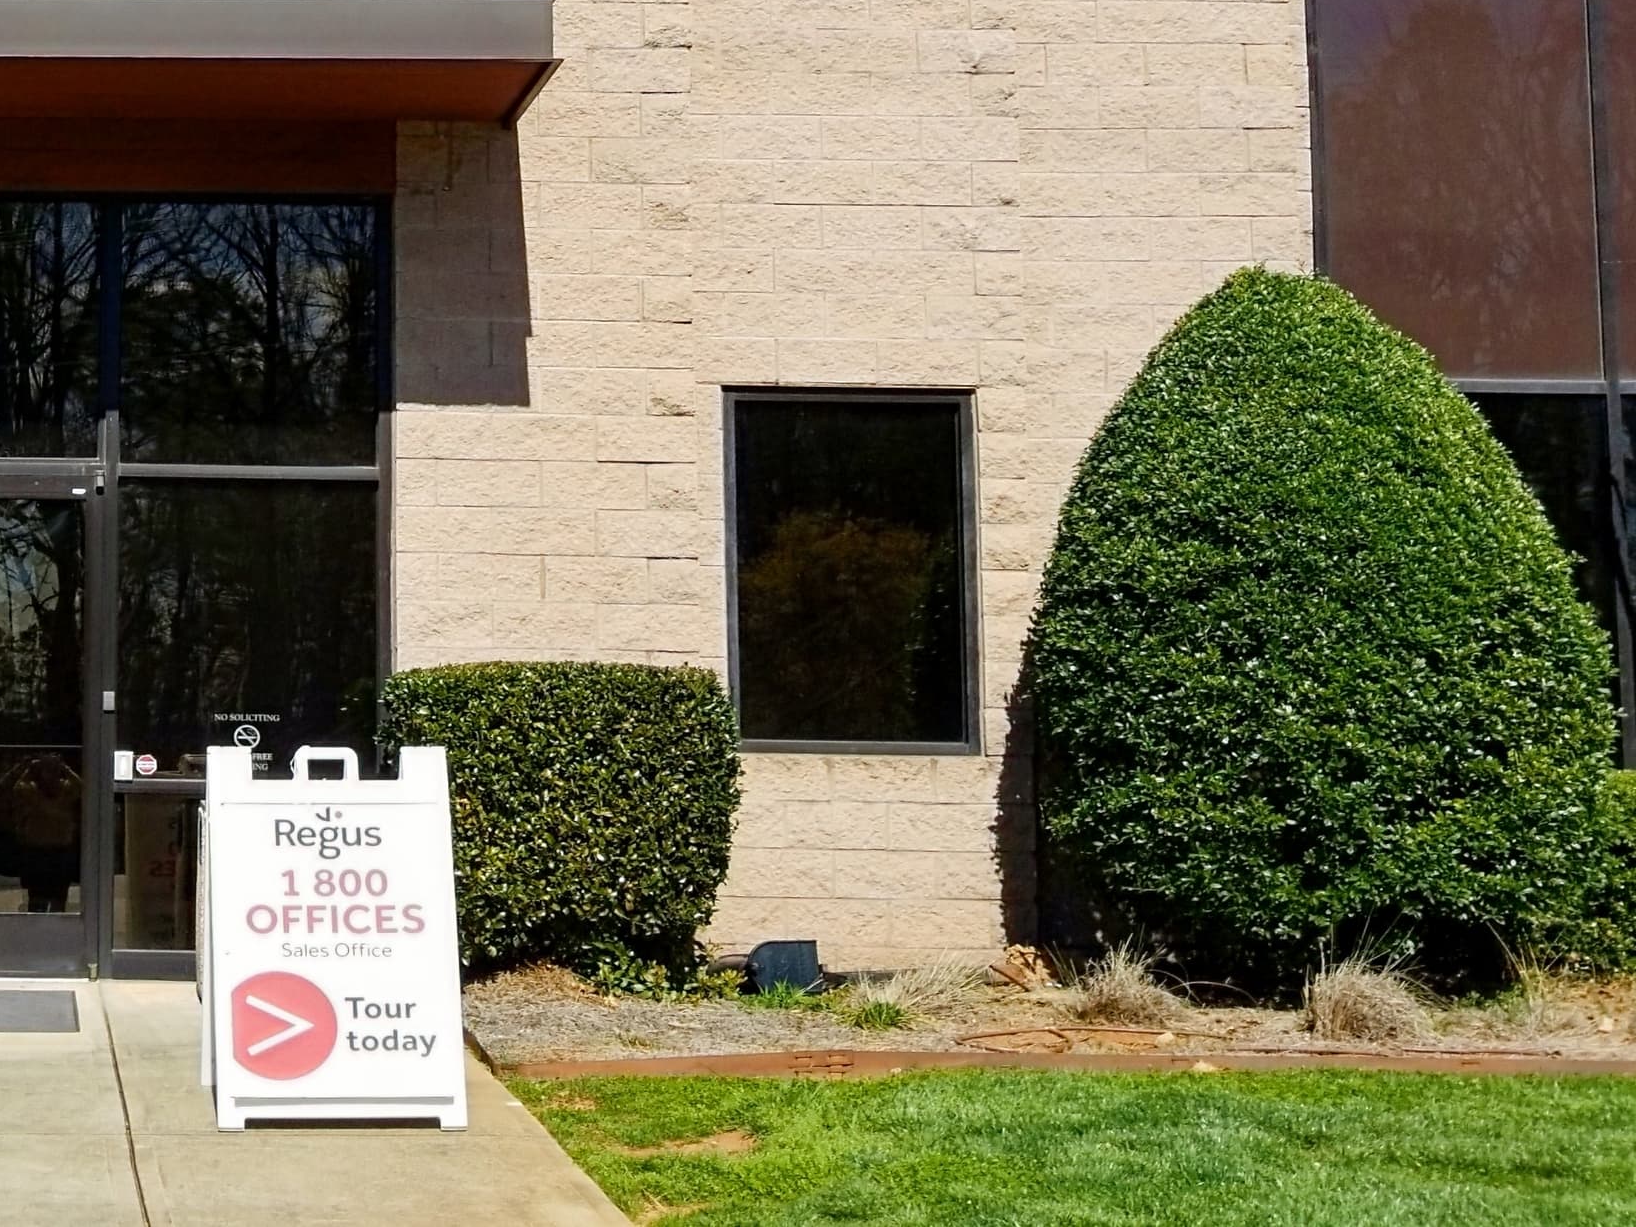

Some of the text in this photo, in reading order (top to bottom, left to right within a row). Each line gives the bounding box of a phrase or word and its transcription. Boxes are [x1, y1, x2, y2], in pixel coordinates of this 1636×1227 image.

[214, 713, 281, 722] NO SOLICITING
[274, 818, 382, 860] Regus
[281, 869, 388, 897] 1 800
[246, 904, 426, 934] OFFICES
[281, 942, 393, 958] Sales Office
[344, 997, 417, 1019] Tour
[346, 1029, 437, 1058] today
